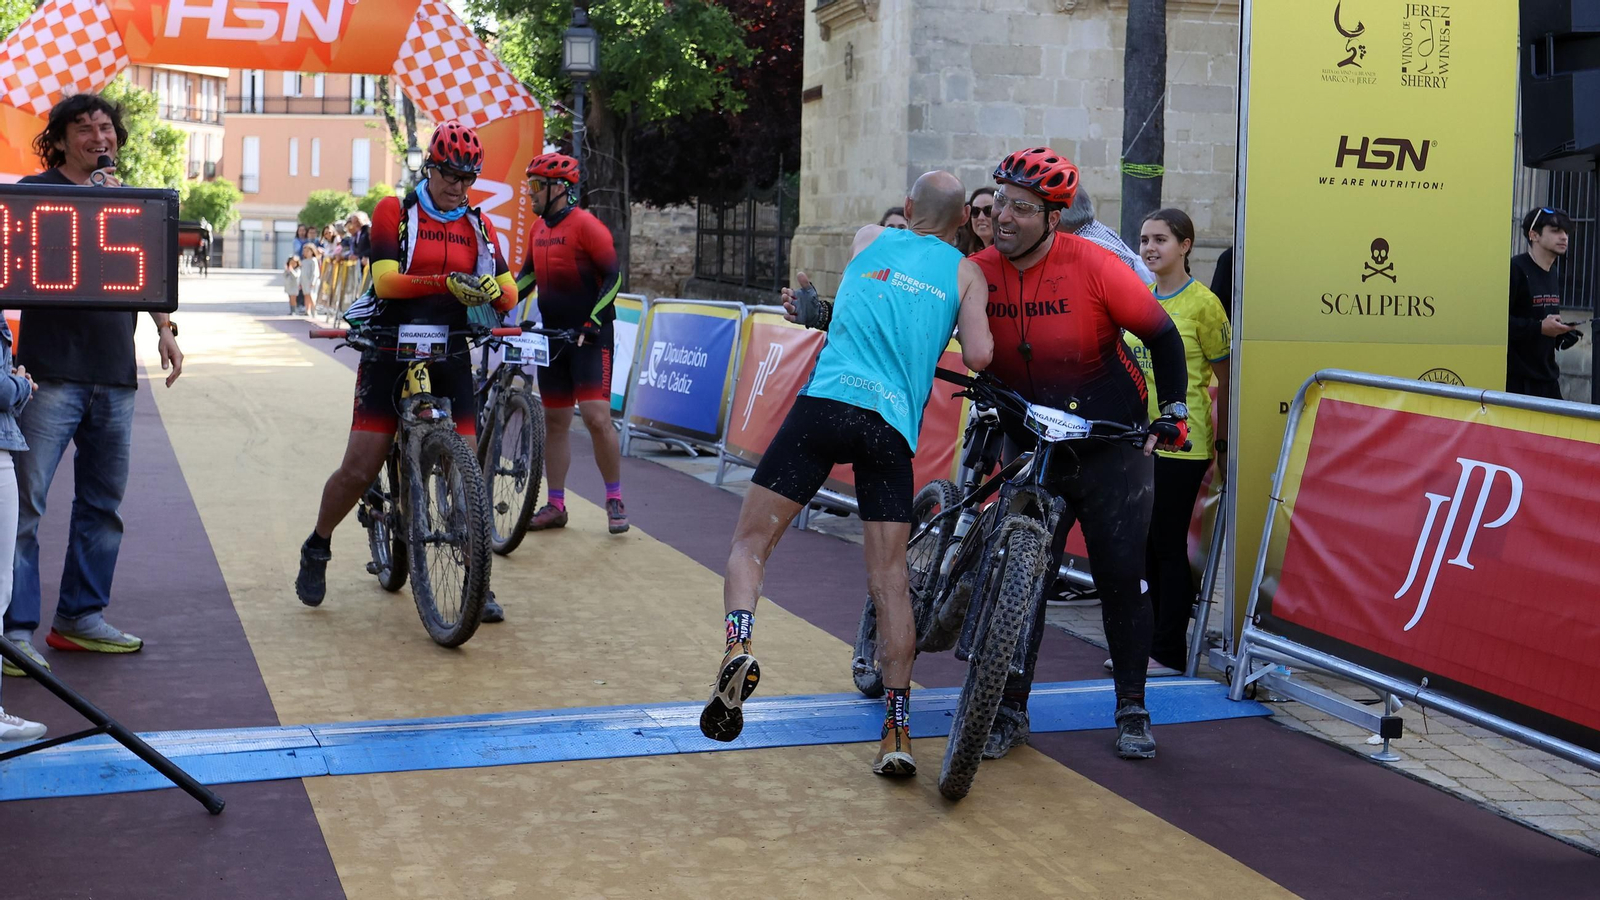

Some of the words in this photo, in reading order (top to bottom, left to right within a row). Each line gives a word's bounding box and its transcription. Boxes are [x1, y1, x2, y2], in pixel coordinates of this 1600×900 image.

[1403, 3, 1451, 20] JEREZ
[1402, 21, 1411, 30] DE
[1402, 31, 1413, 65] VINOS
[1439, 28, 1451, 75] WINES
[1321, 74, 1349, 83] MARCO
[1356, 76, 1377, 85] JEREZ
[1401, 74, 1449, 89] SHERRY
[1318, 177, 1336, 185] WE
[1341, 178, 1365, 186] ARE
[1370, 179, 1444, 190] NUTRITION!
[419, 229, 445, 242] ODO
[448, 231, 473, 247] BIKE
[891, 278, 920, 295] SPORT
[893, 271, 946, 301] ENERGYUM
[985, 302, 1018, 319] ODO
[1024, 298, 1072, 317] BIKE
[1320, 292, 1436, 318] SCALPERS
[400, 331, 446, 339] ORGANIZACIÓN
[664, 342, 708, 368] Diputación
[656, 370, 668, 390] de
[667, 371, 693, 395] Cádiz
[1032, 411, 1087, 430] RGANIZACIÓN
